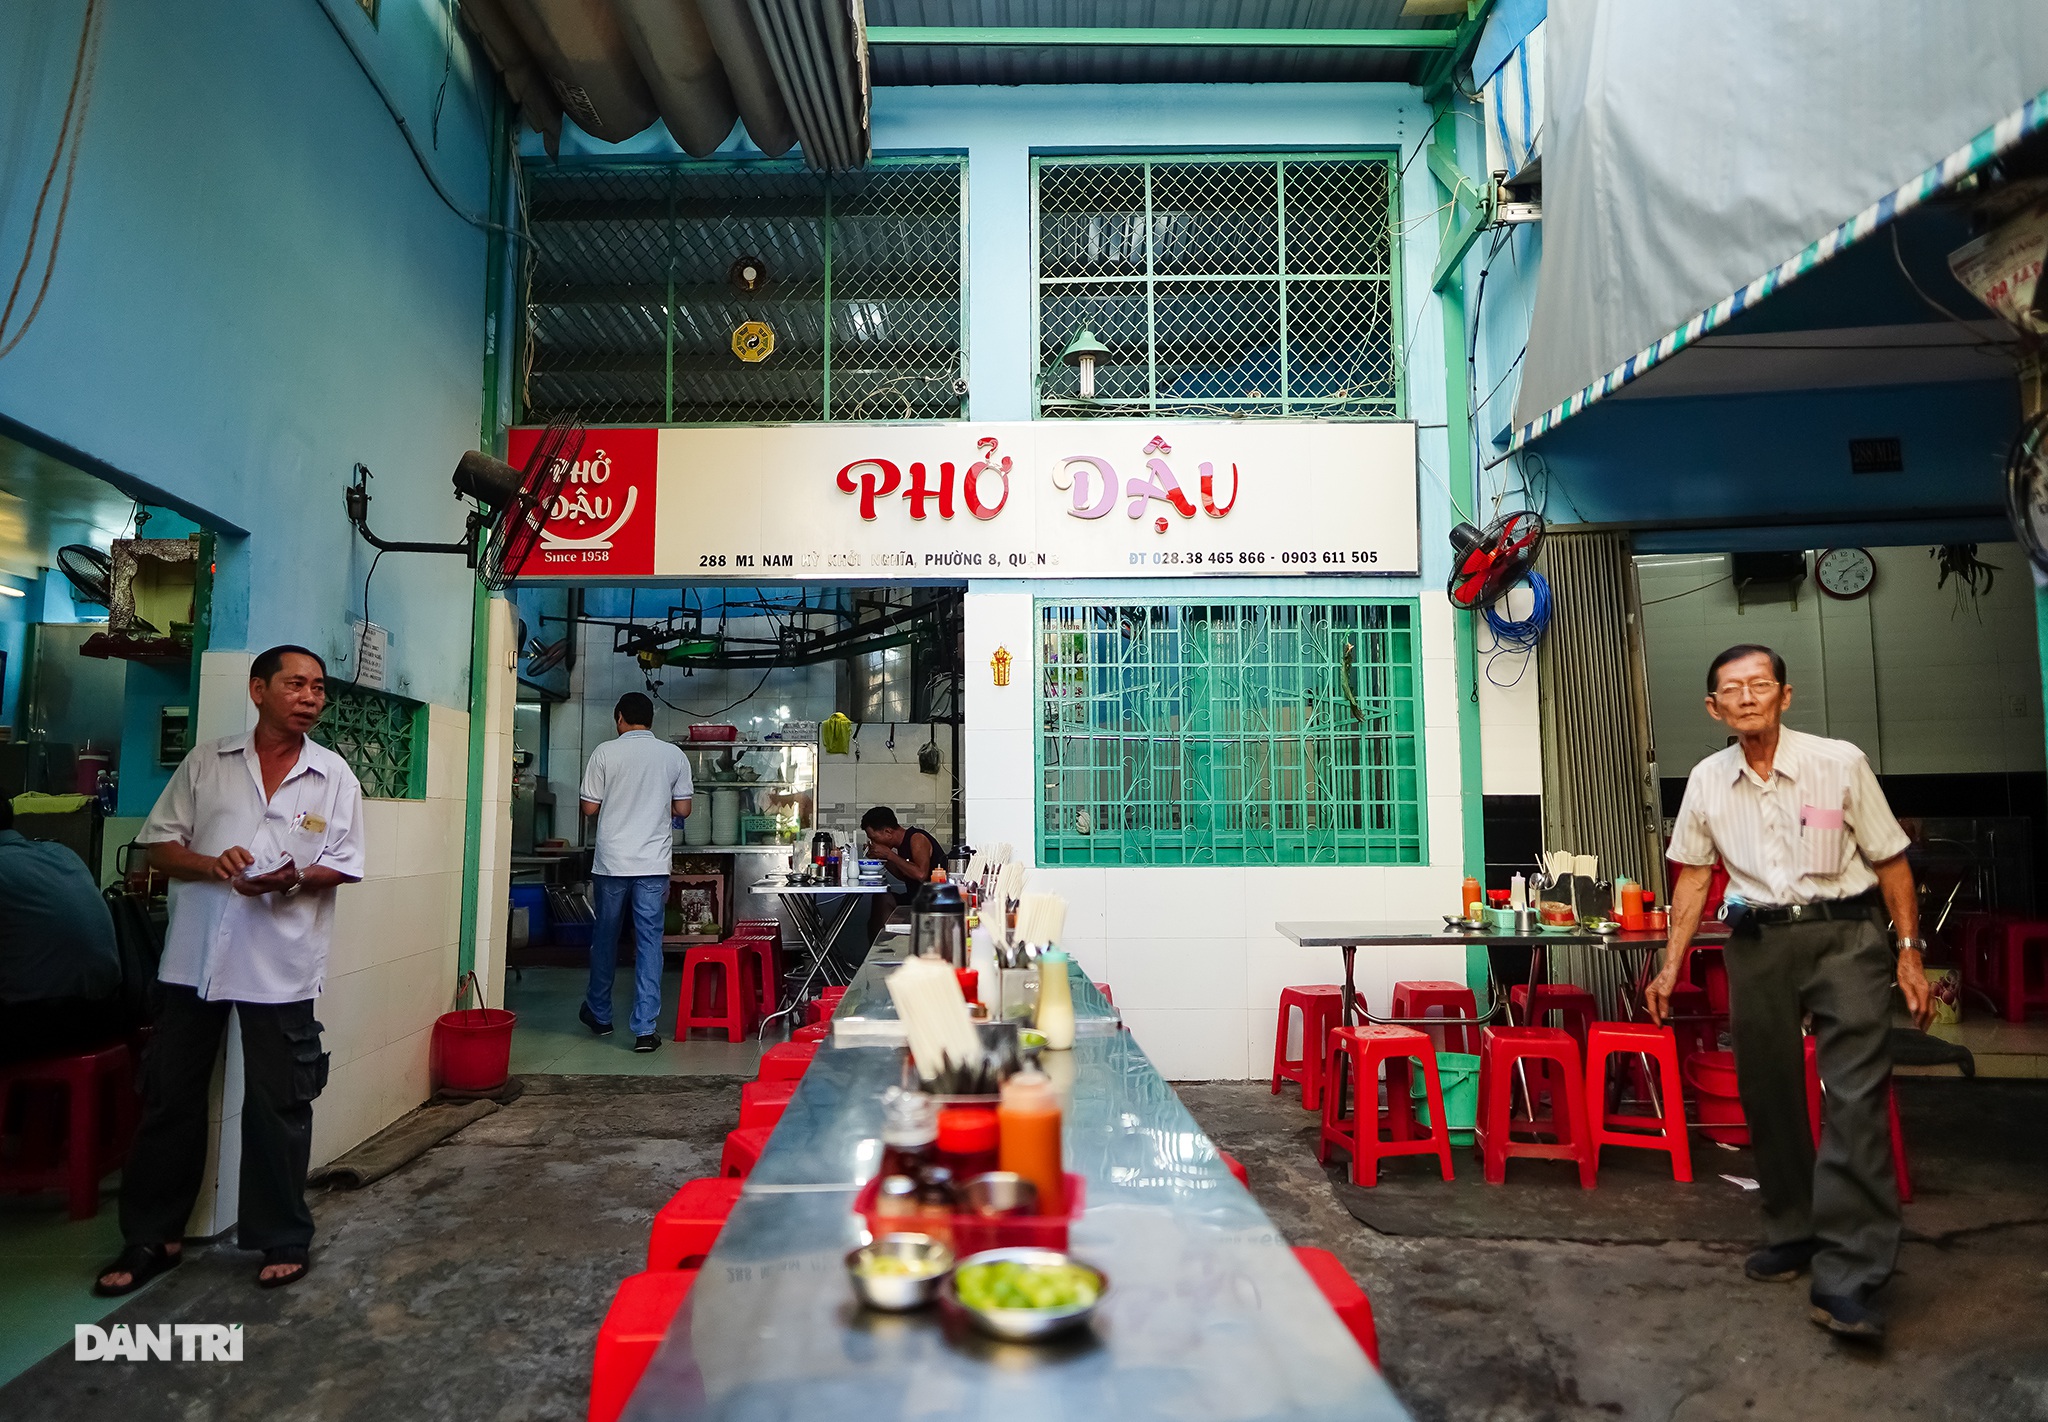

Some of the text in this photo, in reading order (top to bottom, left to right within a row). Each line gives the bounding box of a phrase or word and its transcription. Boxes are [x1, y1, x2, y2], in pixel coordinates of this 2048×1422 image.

[549, 449, 612, 483] PHỞ
[836, 435, 1239, 533] PHỞ DẬU
[541, 487, 613, 525] DẬU
[545, 551, 610, 562] Since 1958
[699, 554, 727, 567] 288
[735, 554, 755, 567] M1
[763, 554, 793, 567] NAM
[925, 549, 982, 566] PHƯỜNG
[989, 553, 1001, 567] 8,
[1129, 553, 1147, 565] ĐT
[1153, 552, 1203, 565] 028.38
[1208, 552, 1234, 565] 465
[1239, 552, 1265, 564] 866
[1281, 551, 1317, 564] 0903
[1322, 551, 1346, 564] 611
[1351, 551, 1378, 563] 505
